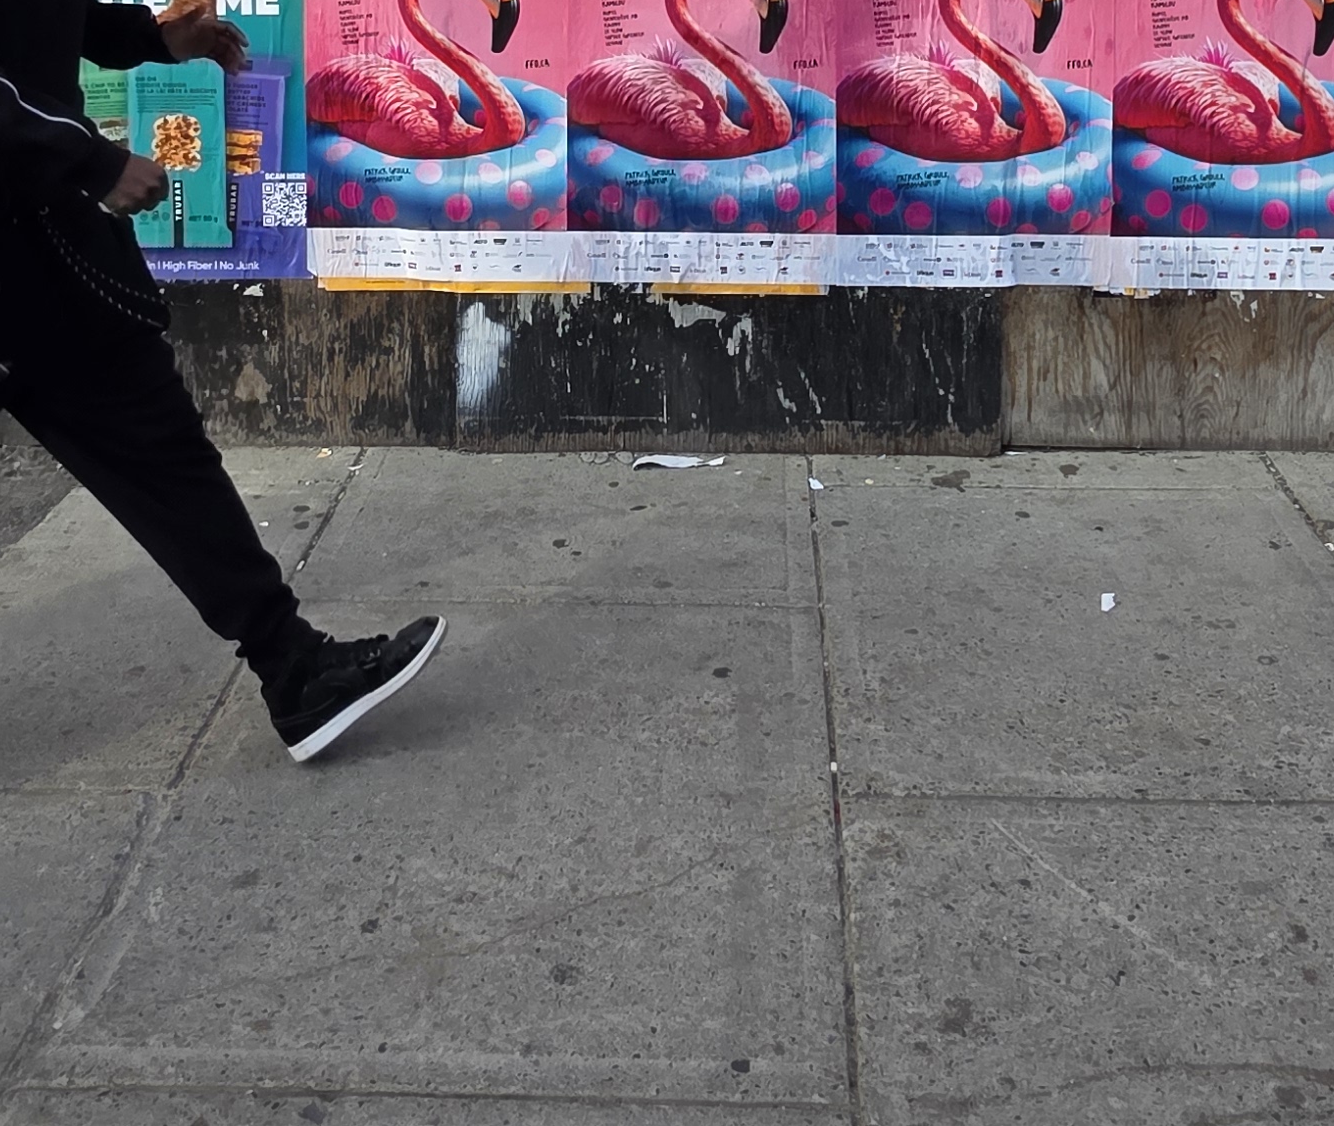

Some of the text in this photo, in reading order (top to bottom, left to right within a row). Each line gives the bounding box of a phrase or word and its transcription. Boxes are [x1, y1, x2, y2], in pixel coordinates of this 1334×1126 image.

[163, 261, 260, 273] High Fiber No Junk
